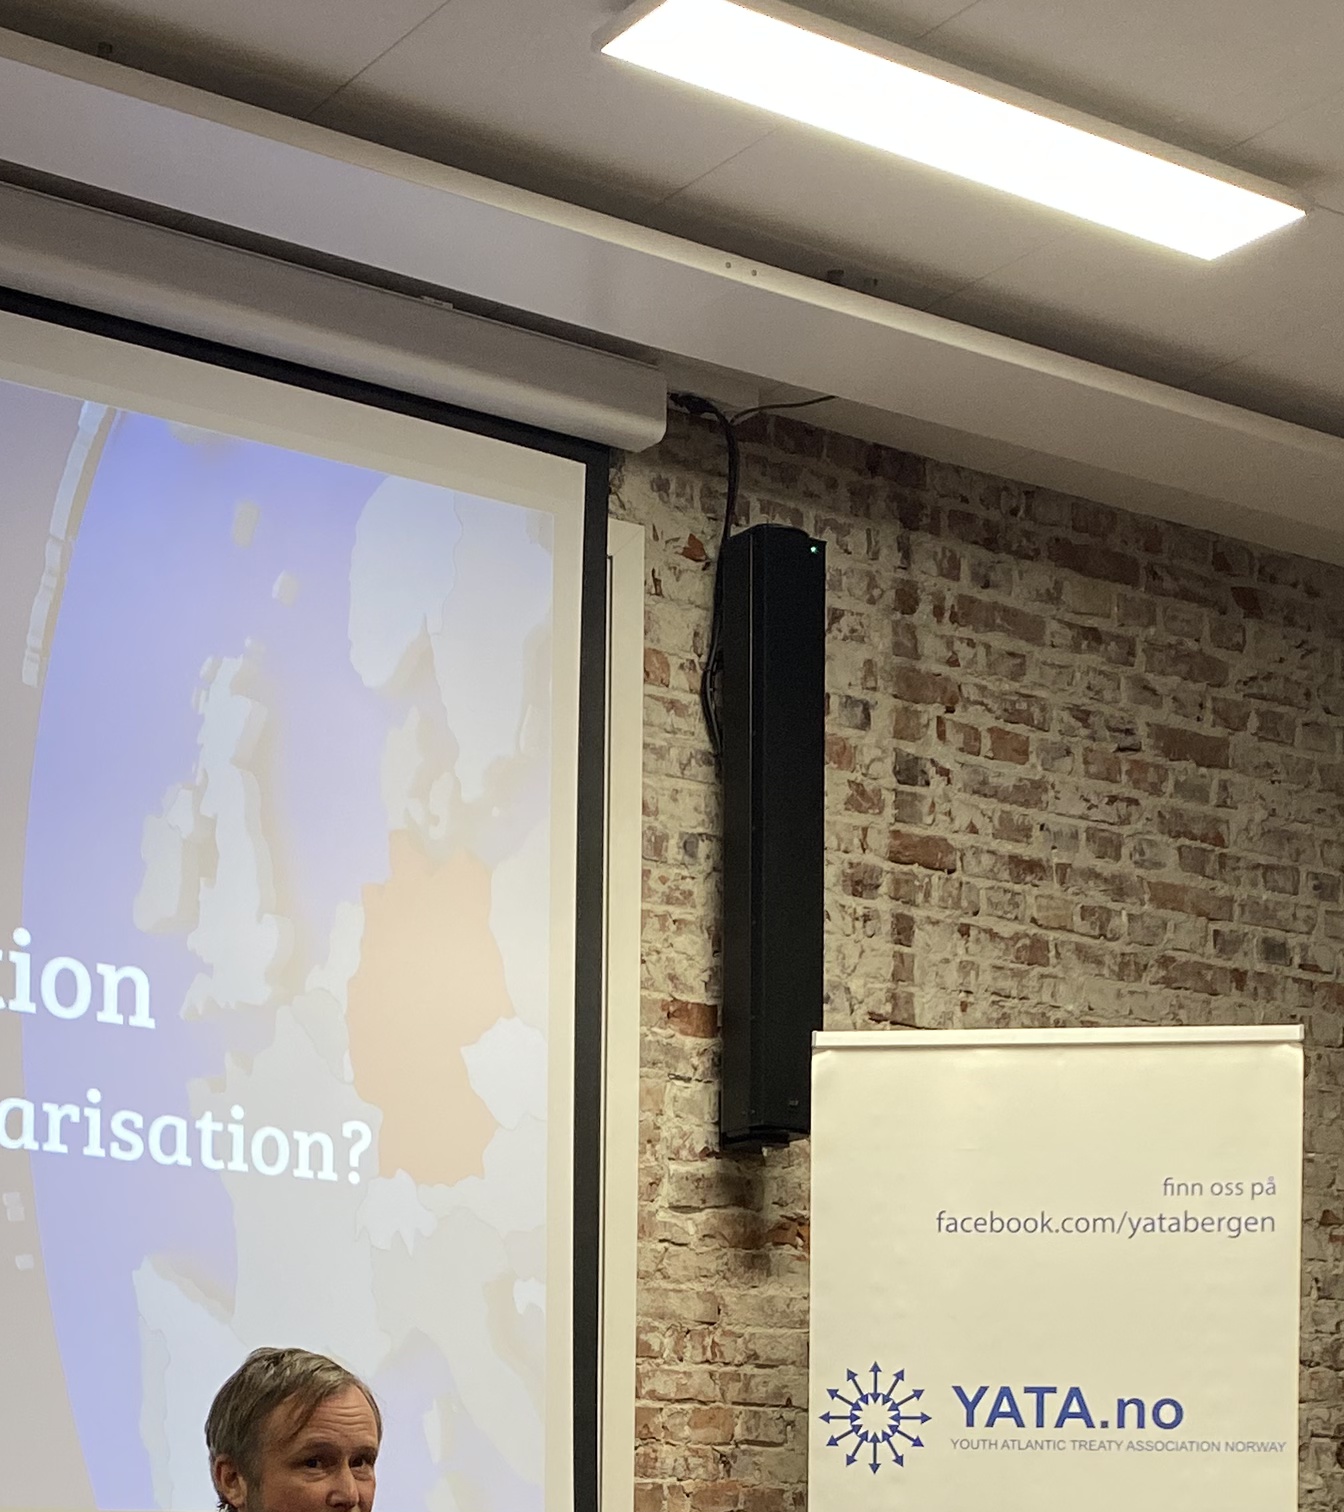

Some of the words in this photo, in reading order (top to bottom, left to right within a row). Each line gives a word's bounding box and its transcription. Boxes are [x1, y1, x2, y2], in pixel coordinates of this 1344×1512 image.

[1163, 1177, 1204, 1197] finn
[1210, 1181, 1244, 1197] oss
[1251, 1176, 1277, 1201] på
[936, 1211, 1276, 1238] facebook.com/yatabergen
[951, 1385, 1184, 1430] YATA.no
[951, 1438, 998, 1451] YOUTH
[1001, 1439, 1066, 1452] ATLANTIC
[1070, 1439, 1123, 1452] TREATY
[1126, 1440, 1221, 1453] ASSOCIATION
[1224, 1441, 1286, 1453] NORWAY
